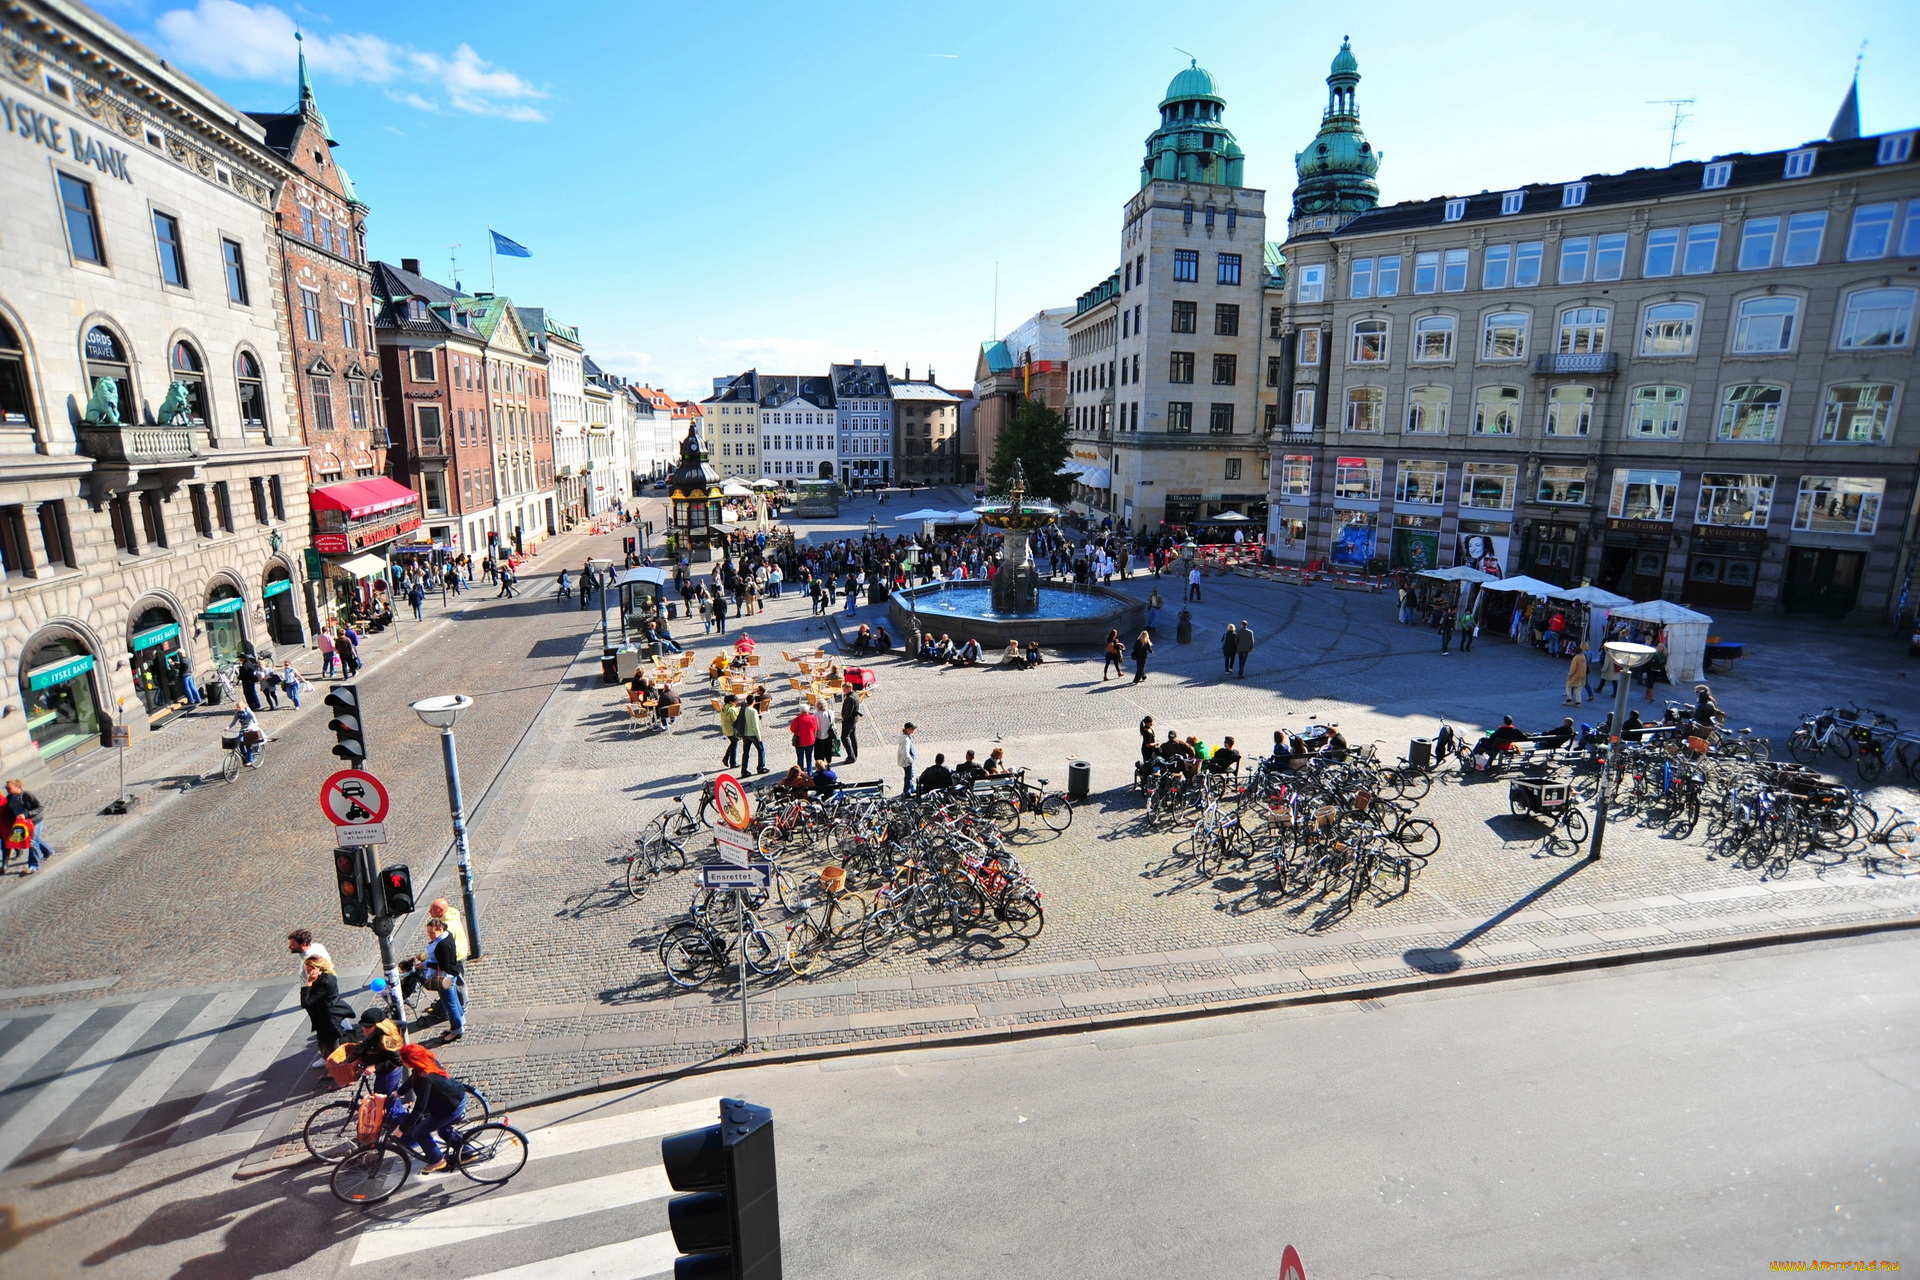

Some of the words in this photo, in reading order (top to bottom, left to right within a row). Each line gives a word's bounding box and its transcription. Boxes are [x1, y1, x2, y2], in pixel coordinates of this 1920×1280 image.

[69, 127, 134, 185] BANK
[88, 345, 115, 358] TRAVEL
[1620, 522, 1664, 531] VICTORIA
[1708, 529, 1757, 538] VICTORIA
[148, 633, 164, 645] JYSKE
[164, 628, 176, 639] BANK
[51, 668, 72, 683] JYSKE
[72, 660, 89, 674] BANK
